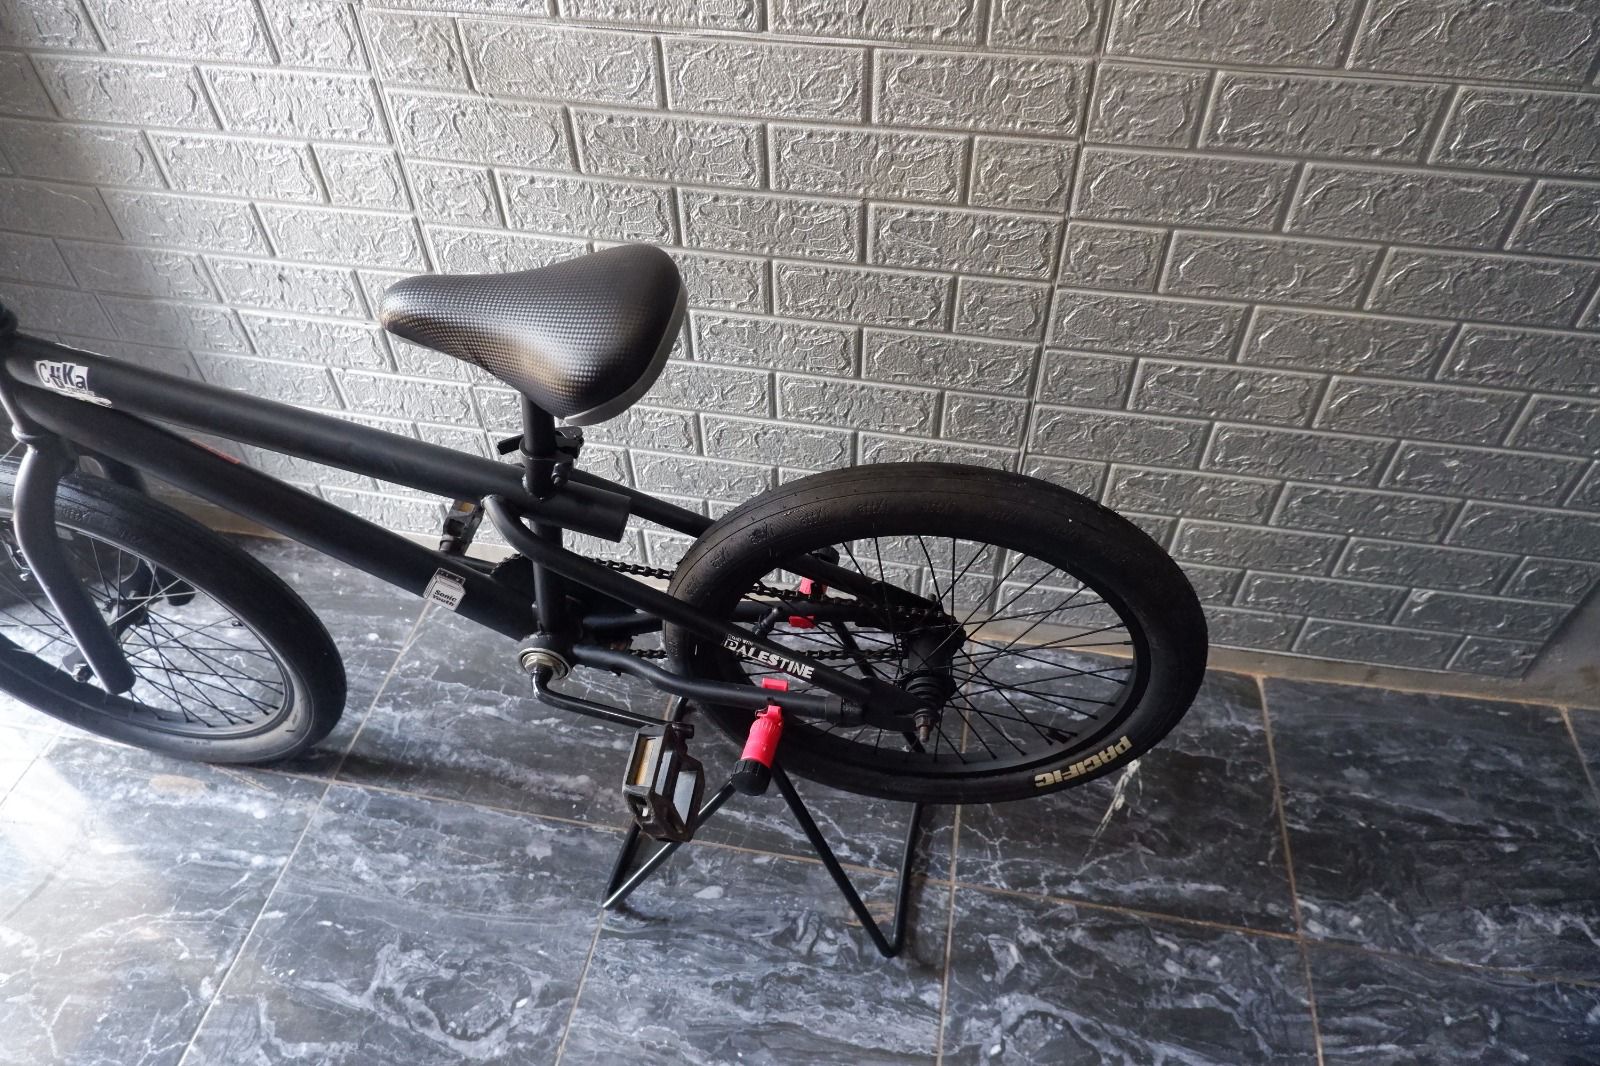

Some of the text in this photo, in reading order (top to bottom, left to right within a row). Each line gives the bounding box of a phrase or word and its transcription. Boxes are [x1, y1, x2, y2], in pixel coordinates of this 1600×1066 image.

[432, 594, 455, 607] Youth
[434, 589, 458, 602] Sonic
[723, 639, 815, 679] PALESTINE
[1034, 735, 1133, 788] PACIFIC
